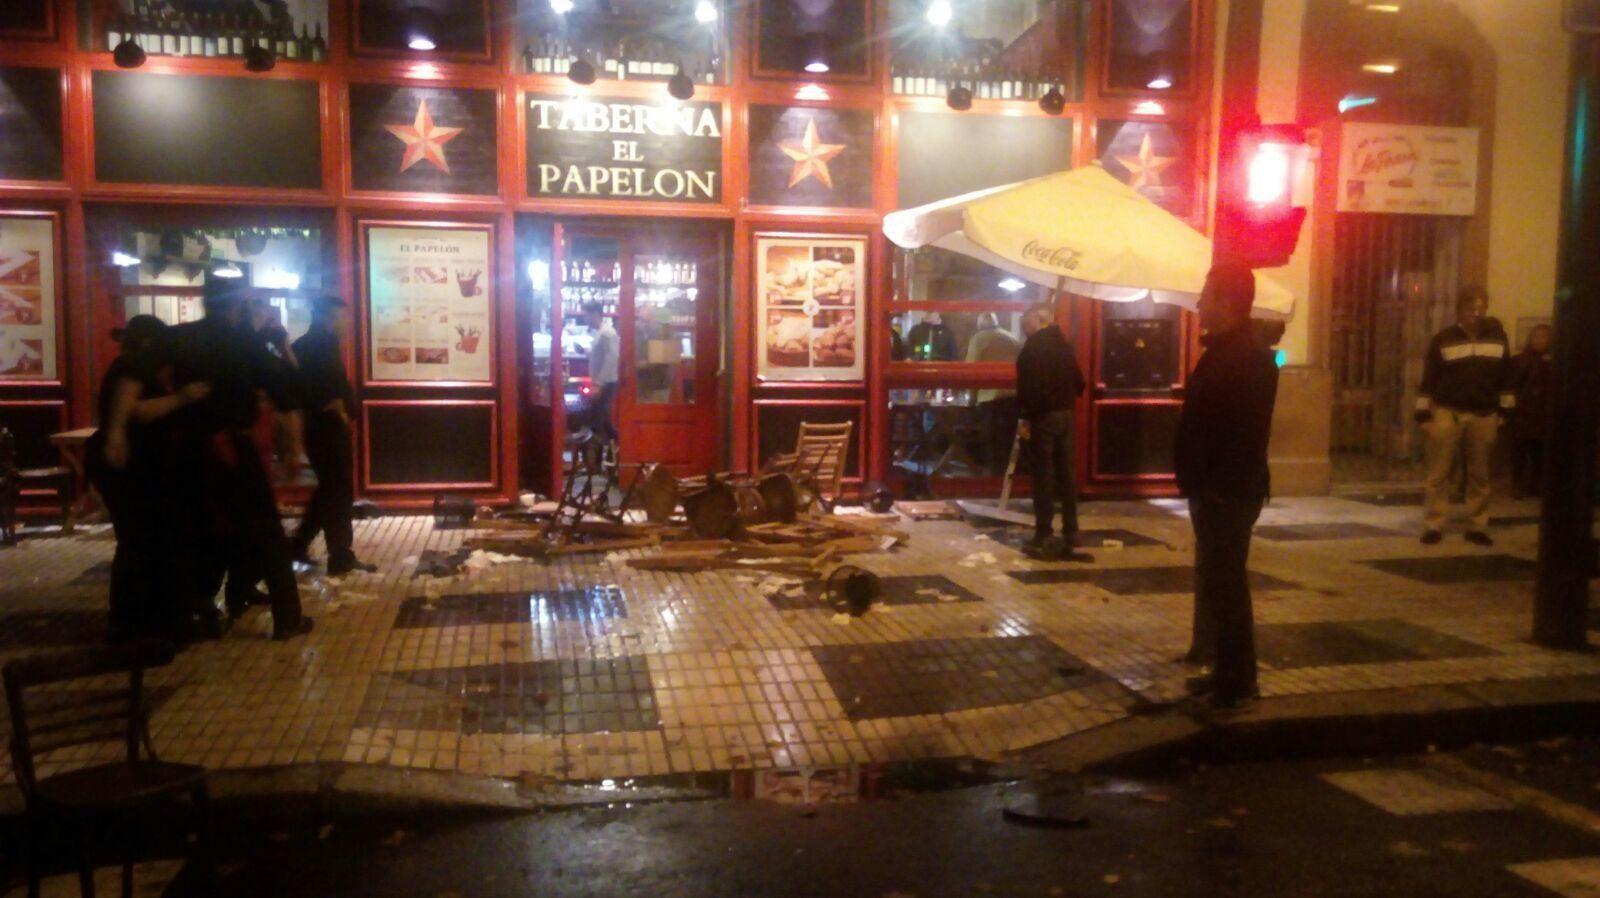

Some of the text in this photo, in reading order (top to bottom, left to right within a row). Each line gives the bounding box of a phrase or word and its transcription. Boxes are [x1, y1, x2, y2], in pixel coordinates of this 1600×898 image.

[530, 99, 721, 137] TABERNA
[612, 140, 644, 162] EL
[538, 163, 716, 198] PAPELON
[400, 244, 411, 253] EL
